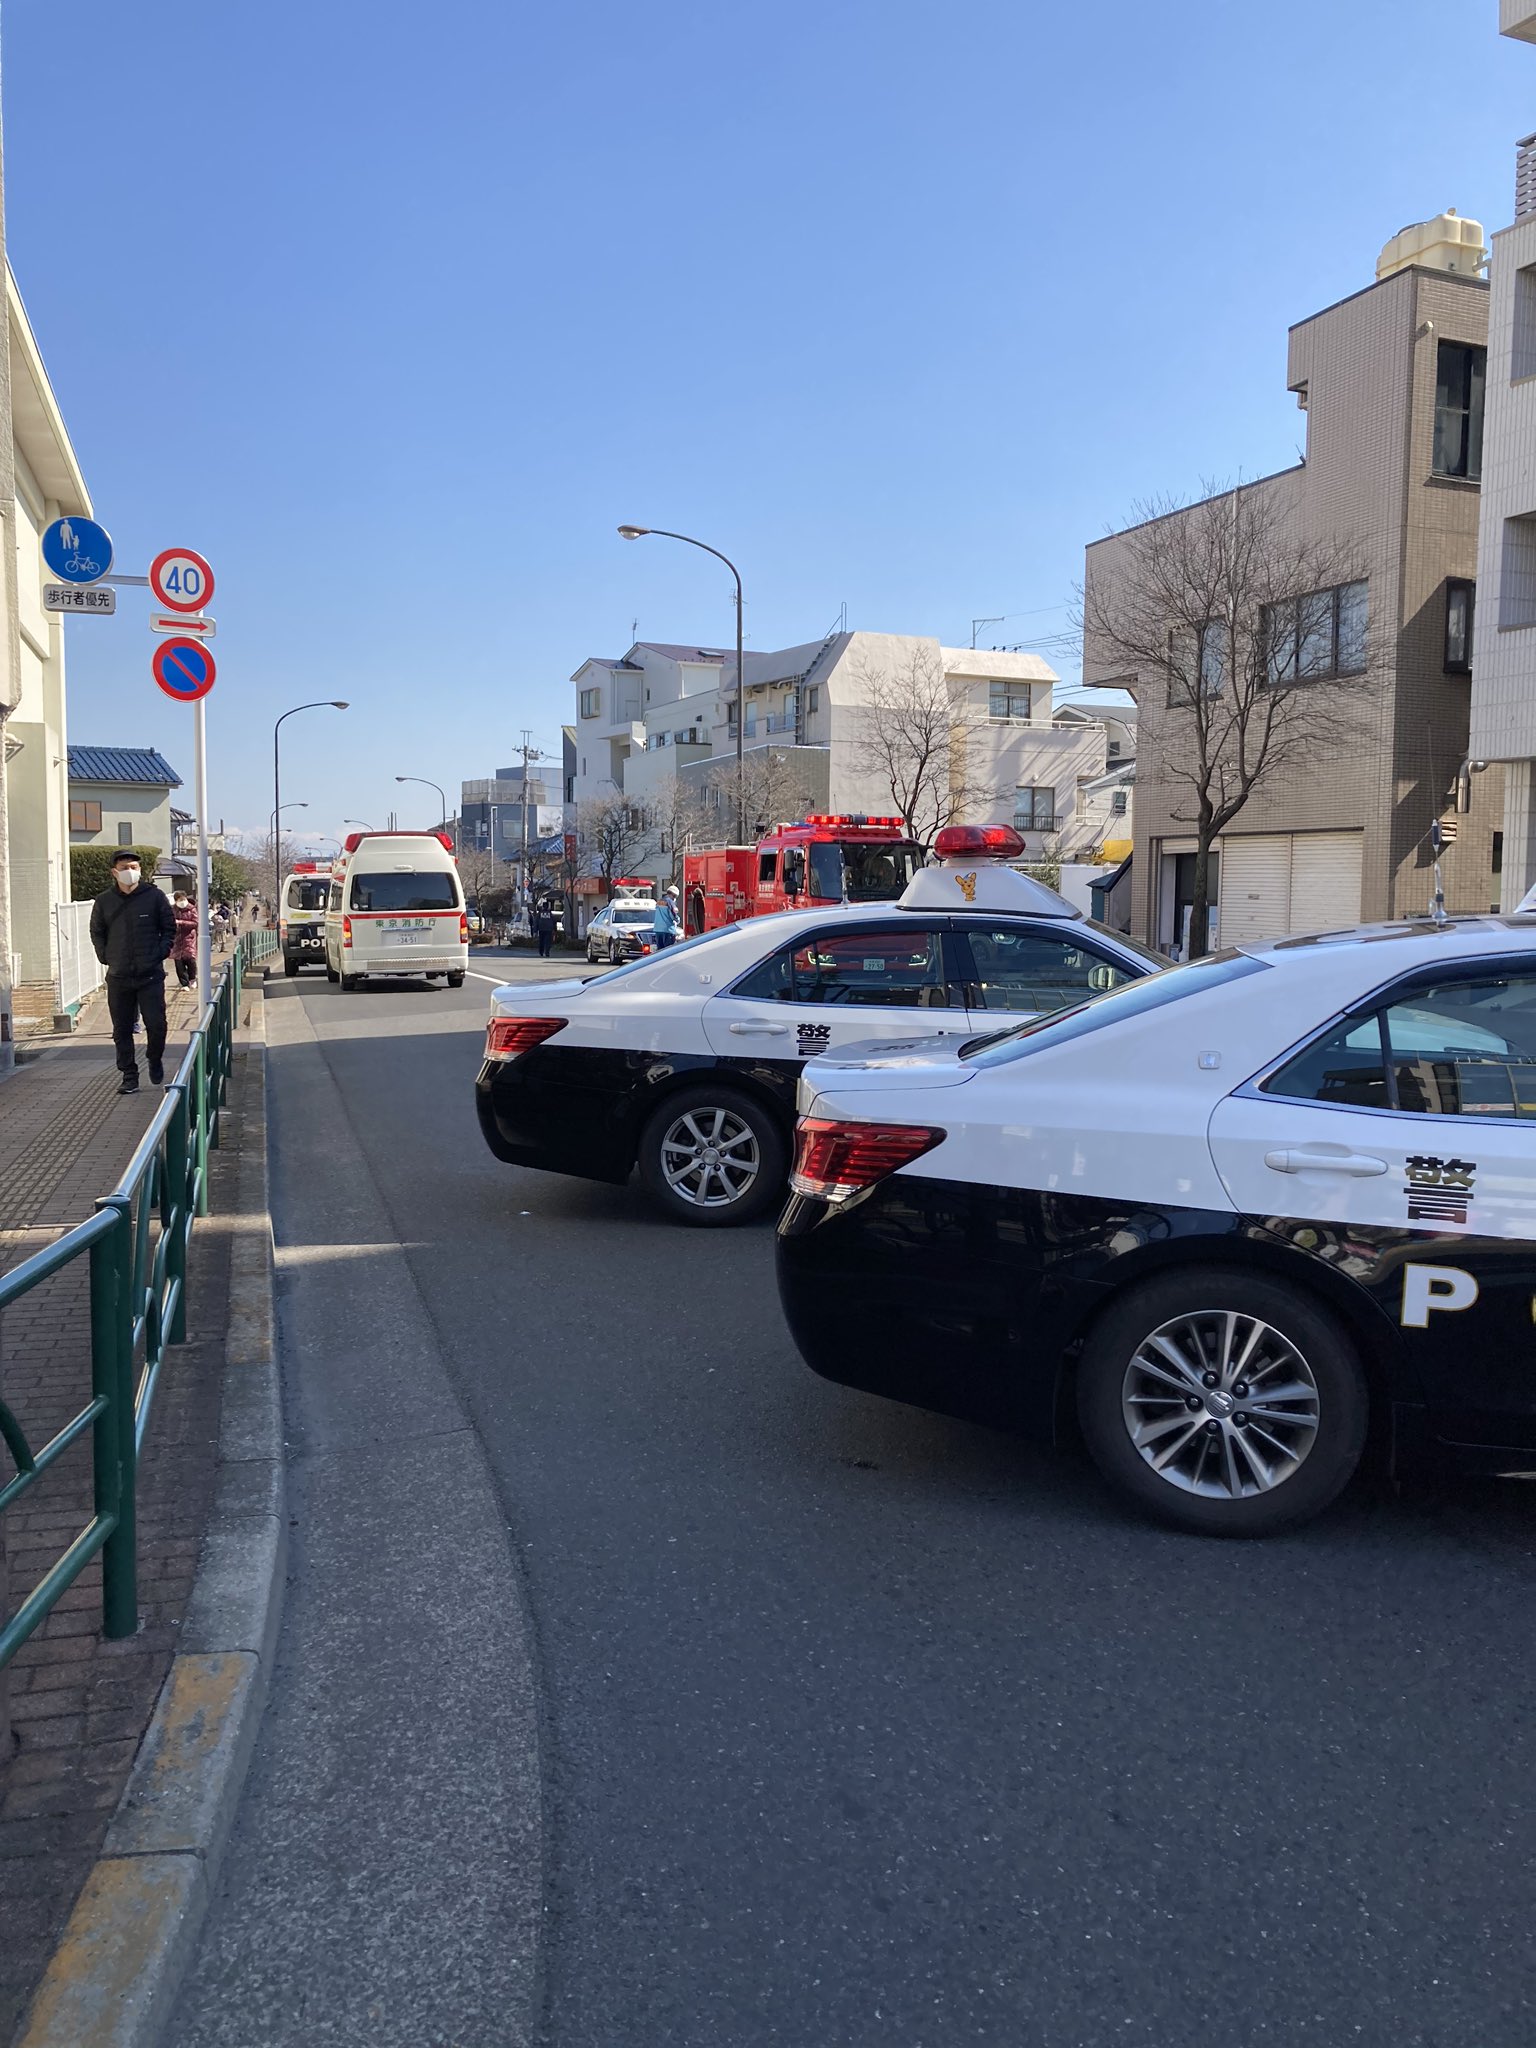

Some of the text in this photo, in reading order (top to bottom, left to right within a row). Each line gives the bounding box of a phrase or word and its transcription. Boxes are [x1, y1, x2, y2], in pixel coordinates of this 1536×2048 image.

[165, 566, 200, 595] 40
[47, 590, 111, 608] 歩行者優先
[375, 918, 437, 928] 東京消防庁
[1403, 1155, 1477, 1224] 警
